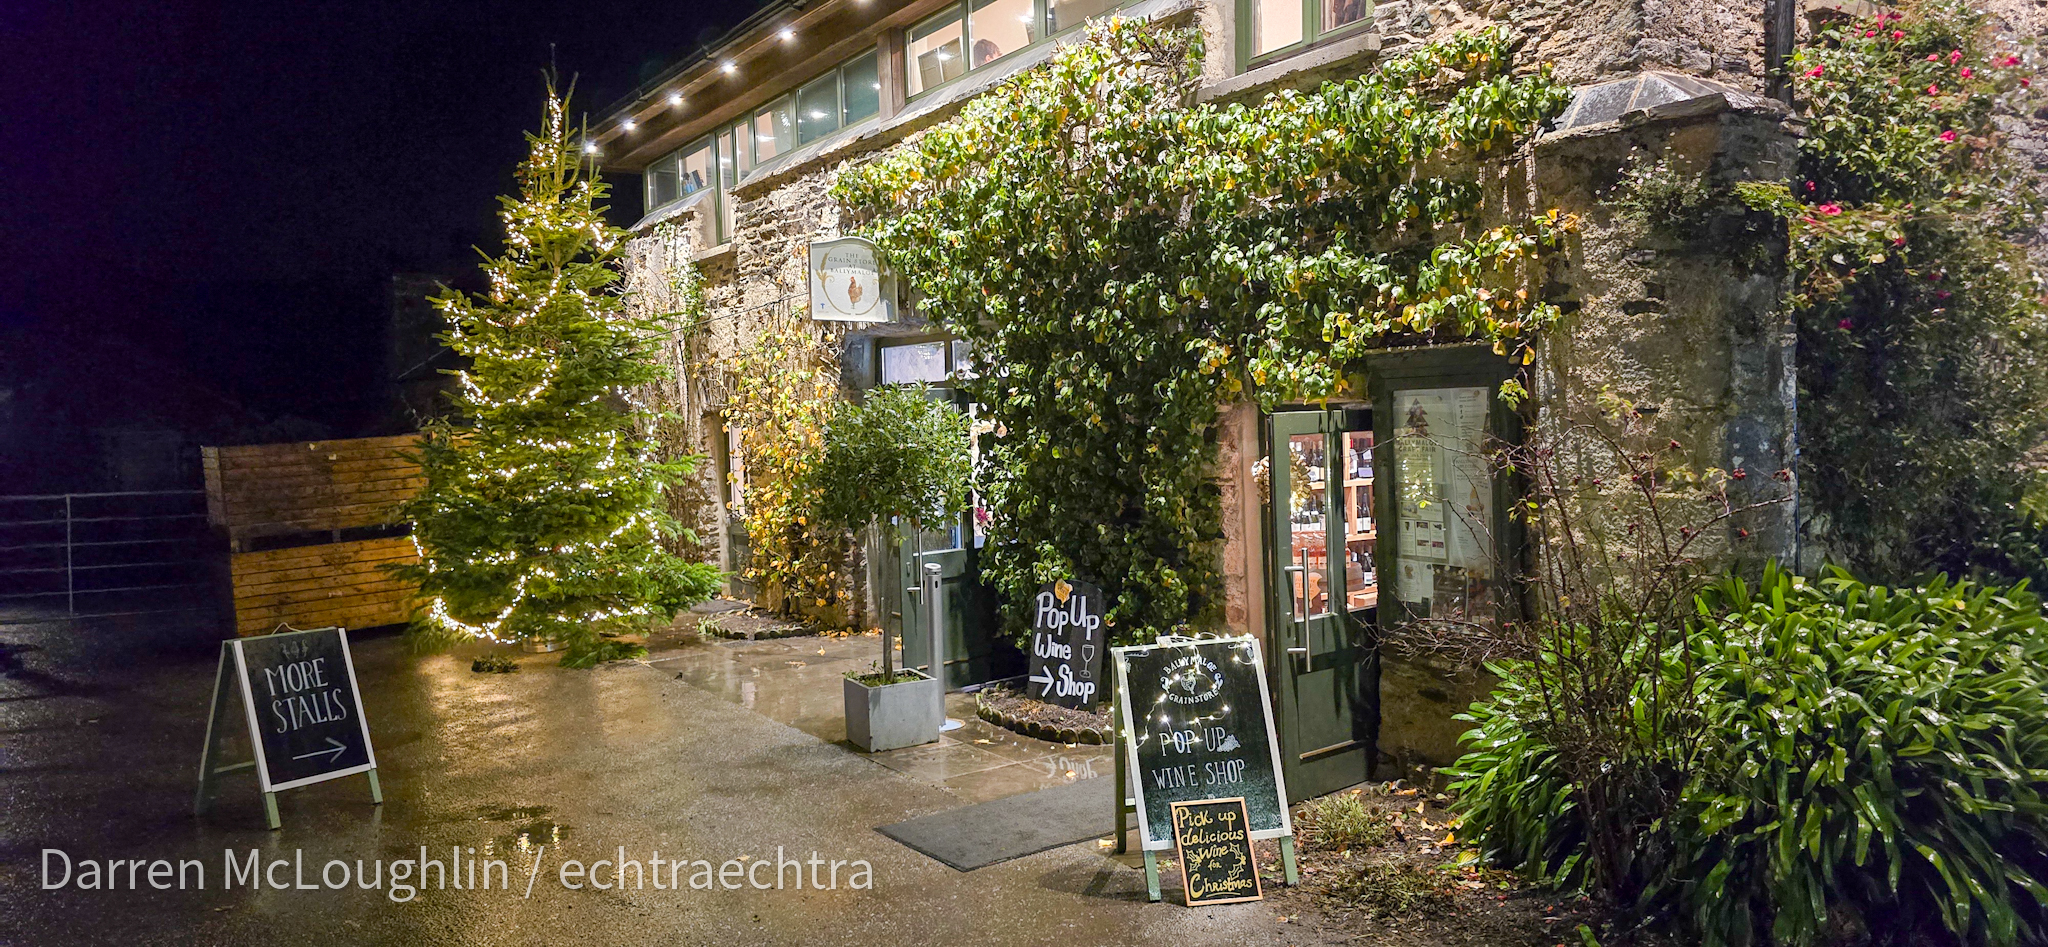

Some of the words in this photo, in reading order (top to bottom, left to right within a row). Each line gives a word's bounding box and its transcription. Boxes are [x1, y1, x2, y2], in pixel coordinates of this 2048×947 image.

[1034, 632, 1072, 661] Wine
[264, 657, 329, 696] MORE
[1162, 656, 1218, 676] BALLYMALOE
[1056, 664, 1096, 704] Shop
[1168, 689, 1219, 705] GRAINSTORE
[272, 688, 347, 733] STALLS
[1159, 730, 1196, 757] POP
[1204, 726, 1226, 752] UP
[1152, 764, 1199, 790] WINE
[1205, 758, 1246, 785] SHOP
[1175, 806, 1213, 829] Pick
[1218, 811, 1236, 832] up
[1181, 827, 1244, 847] delicious
